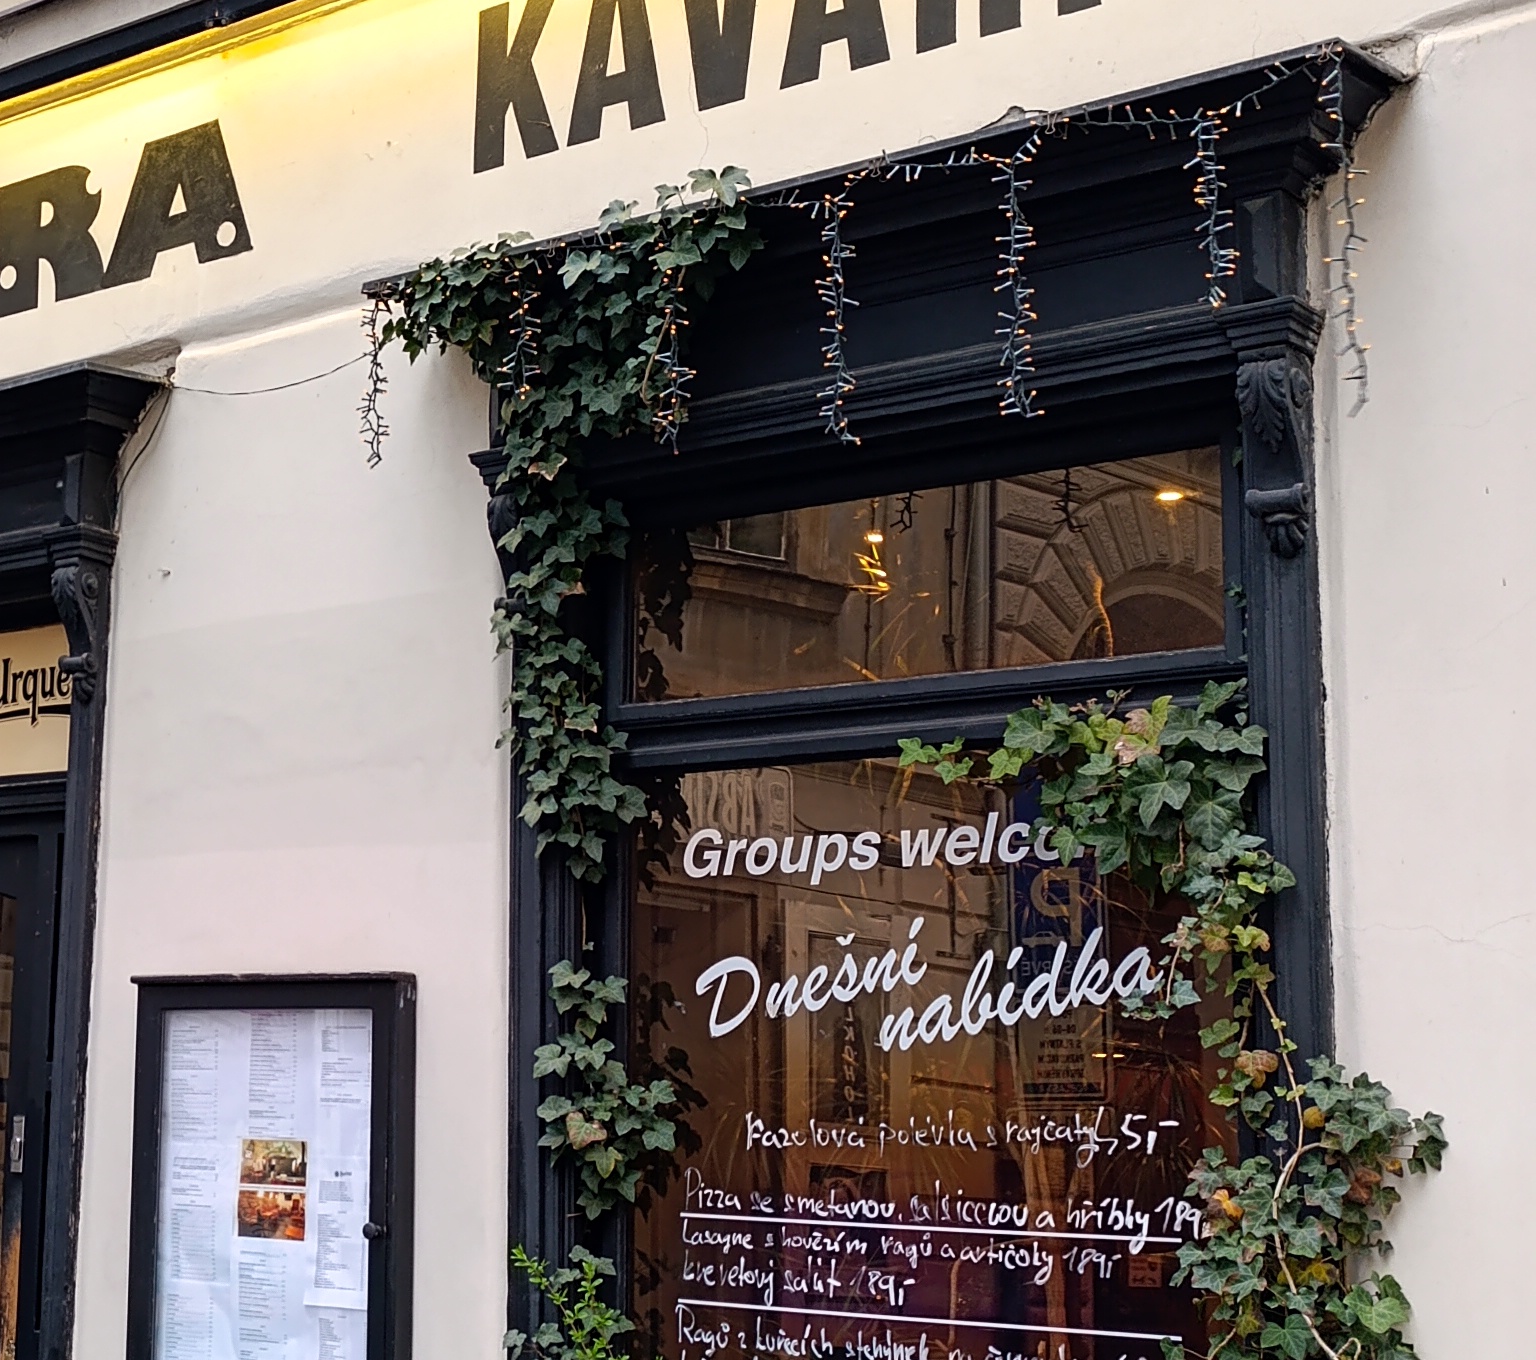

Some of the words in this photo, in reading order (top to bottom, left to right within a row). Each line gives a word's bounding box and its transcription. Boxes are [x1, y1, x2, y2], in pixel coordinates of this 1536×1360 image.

[683, 828, 880, 885] Groups
[696, 916, 928, 1039] Dnešní
[875, 926, 1164, 1053] nabídka
[745, 1111, 866, 1150] Fazolová
[684, 1166, 741, 1210] Pizza
[750, 1191, 774, 1213] se
[1035, 1211, 1056, 1228] a
[941, 1244, 955, 1258] a
[675, 1304, 730, 1357] Ragů
